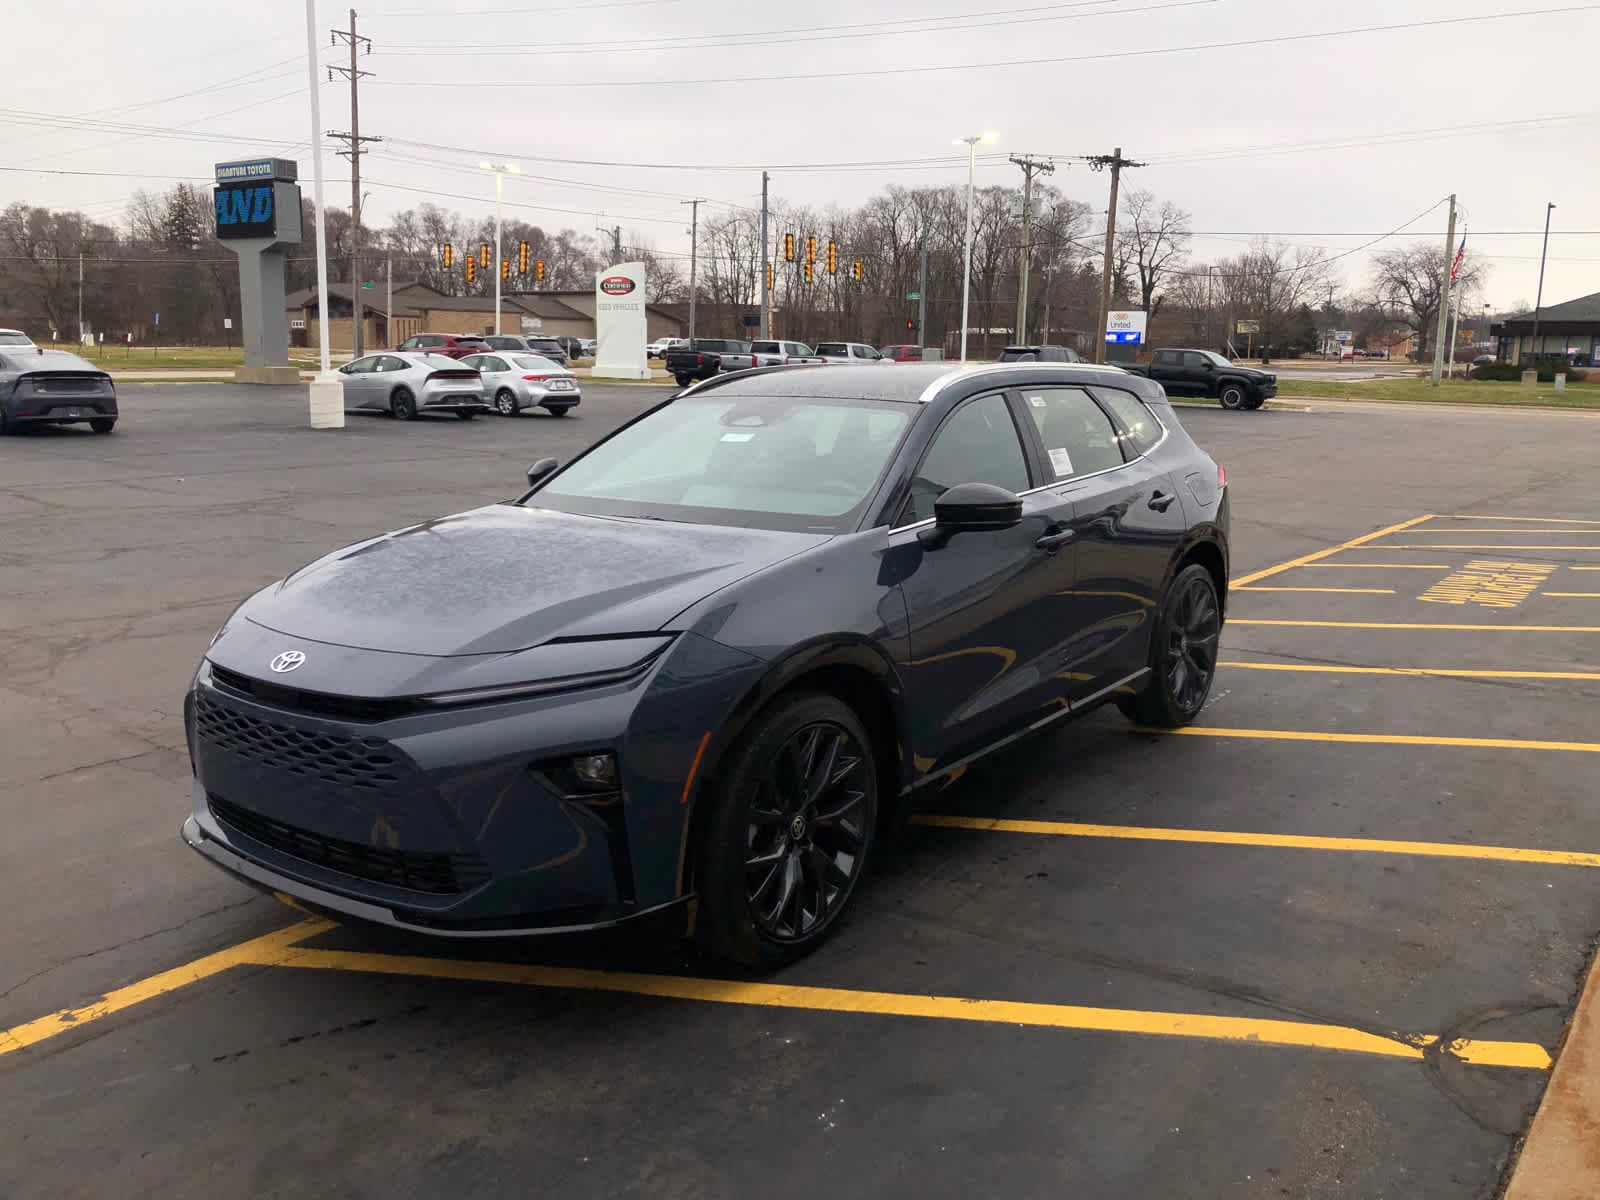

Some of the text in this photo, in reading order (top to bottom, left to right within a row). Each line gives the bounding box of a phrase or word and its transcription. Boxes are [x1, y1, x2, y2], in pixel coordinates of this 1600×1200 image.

[248, 164, 271, 174] TOYOTA
[215, 187, 272, 224] AND
[1416, 570, 1548, 608] PARKING
